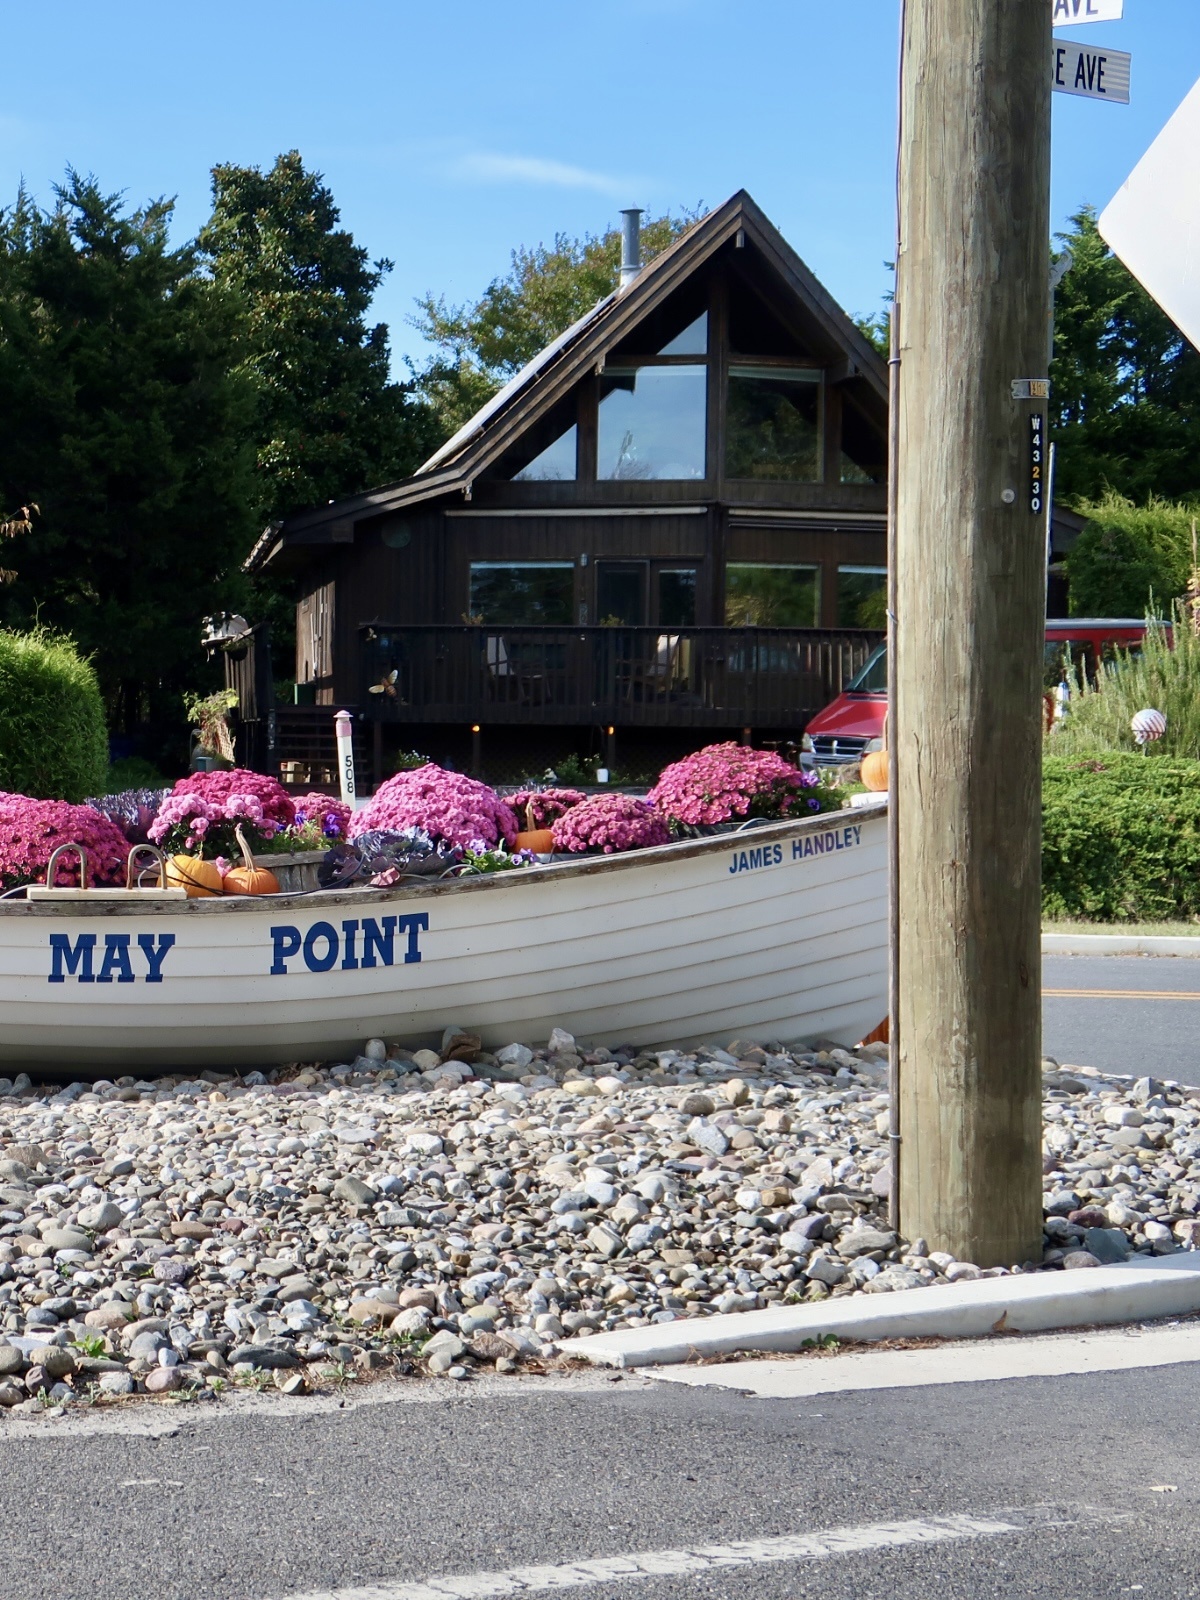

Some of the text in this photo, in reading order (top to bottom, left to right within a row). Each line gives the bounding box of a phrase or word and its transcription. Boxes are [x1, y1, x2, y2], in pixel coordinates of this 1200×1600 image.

[1075, 53, 1107, 93] AVE
[1031, 417, 1041, 511] W43230
[345, 755, 354, 794] 508
[729, 825, 862, 874] JAMES HANDLEY
[48, 933, 176, 983] MAY
[270, 912, 430, 975] POINT
